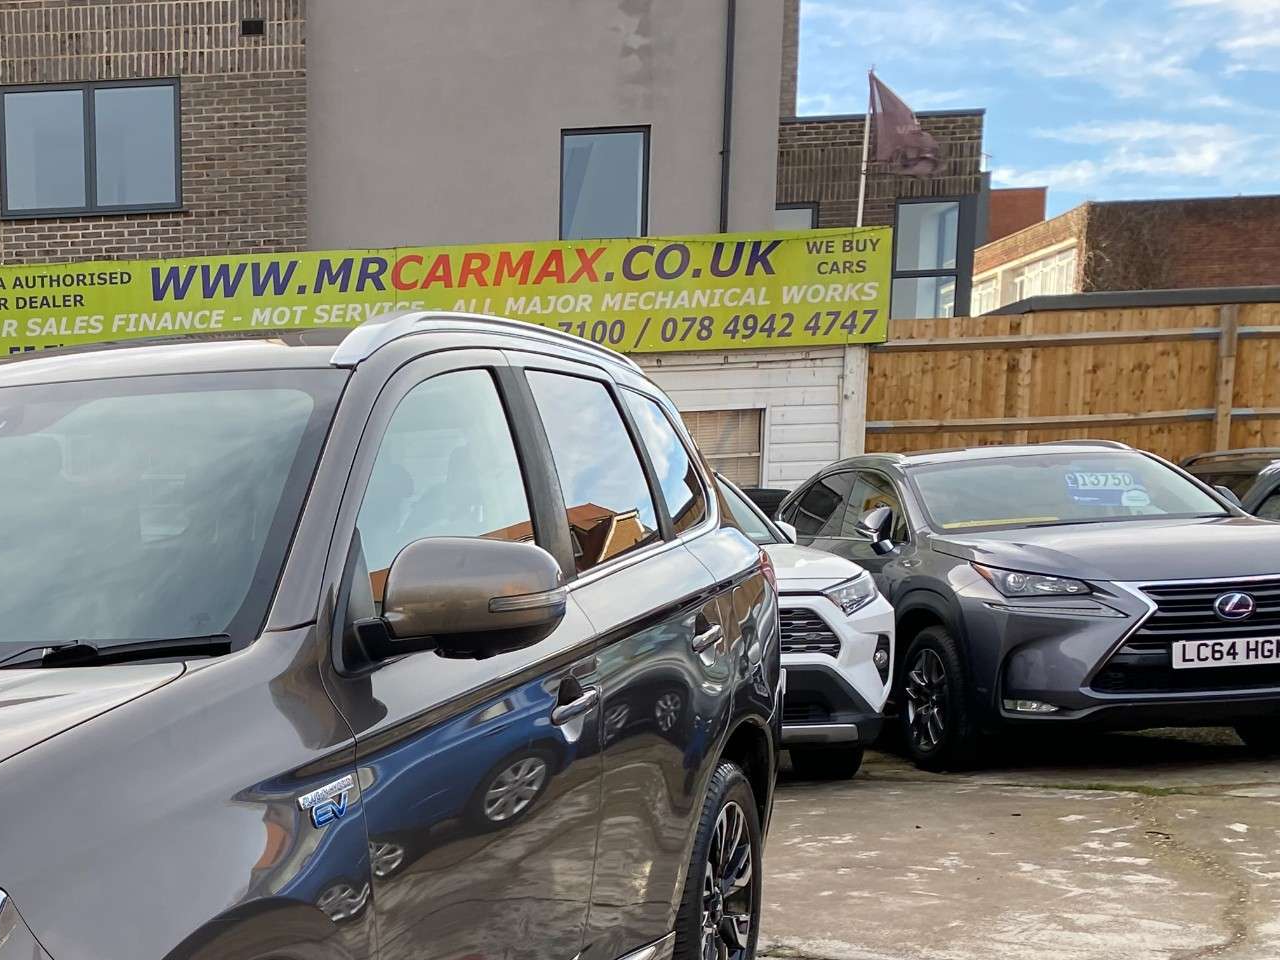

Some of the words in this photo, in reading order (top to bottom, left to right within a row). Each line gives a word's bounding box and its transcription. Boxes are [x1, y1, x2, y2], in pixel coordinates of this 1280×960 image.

[806, 240, 836, 255] WE
[840, 238, 881, 254] BUY
[151, 239, 785, 302] WWW.MRCARMAX.CO.UK
[817, 259, 867, 275] CARS
[13, 271, 133, 290] AUTHORISED
[14, 294, 86, 310] DEALER
[25, 314, 105, 337] SALES
[111, 309, 224, 333] FINANCE
[250, 307, 305, 327] MOT
[452, 297, 496, 316] ALL
[505, 293, 594, 315] MAJOR
[612, 287, 770, 313] MECHANICAL
[782, 281, 880, 305] WORKS
[659, 316, 714, 343] 078
[722, 312, 794, 341] 4942
[803, 308, 879, 337] 4747
[1181, 641, 1239, 663] LC64
[312, 790, 349, 829] EV
